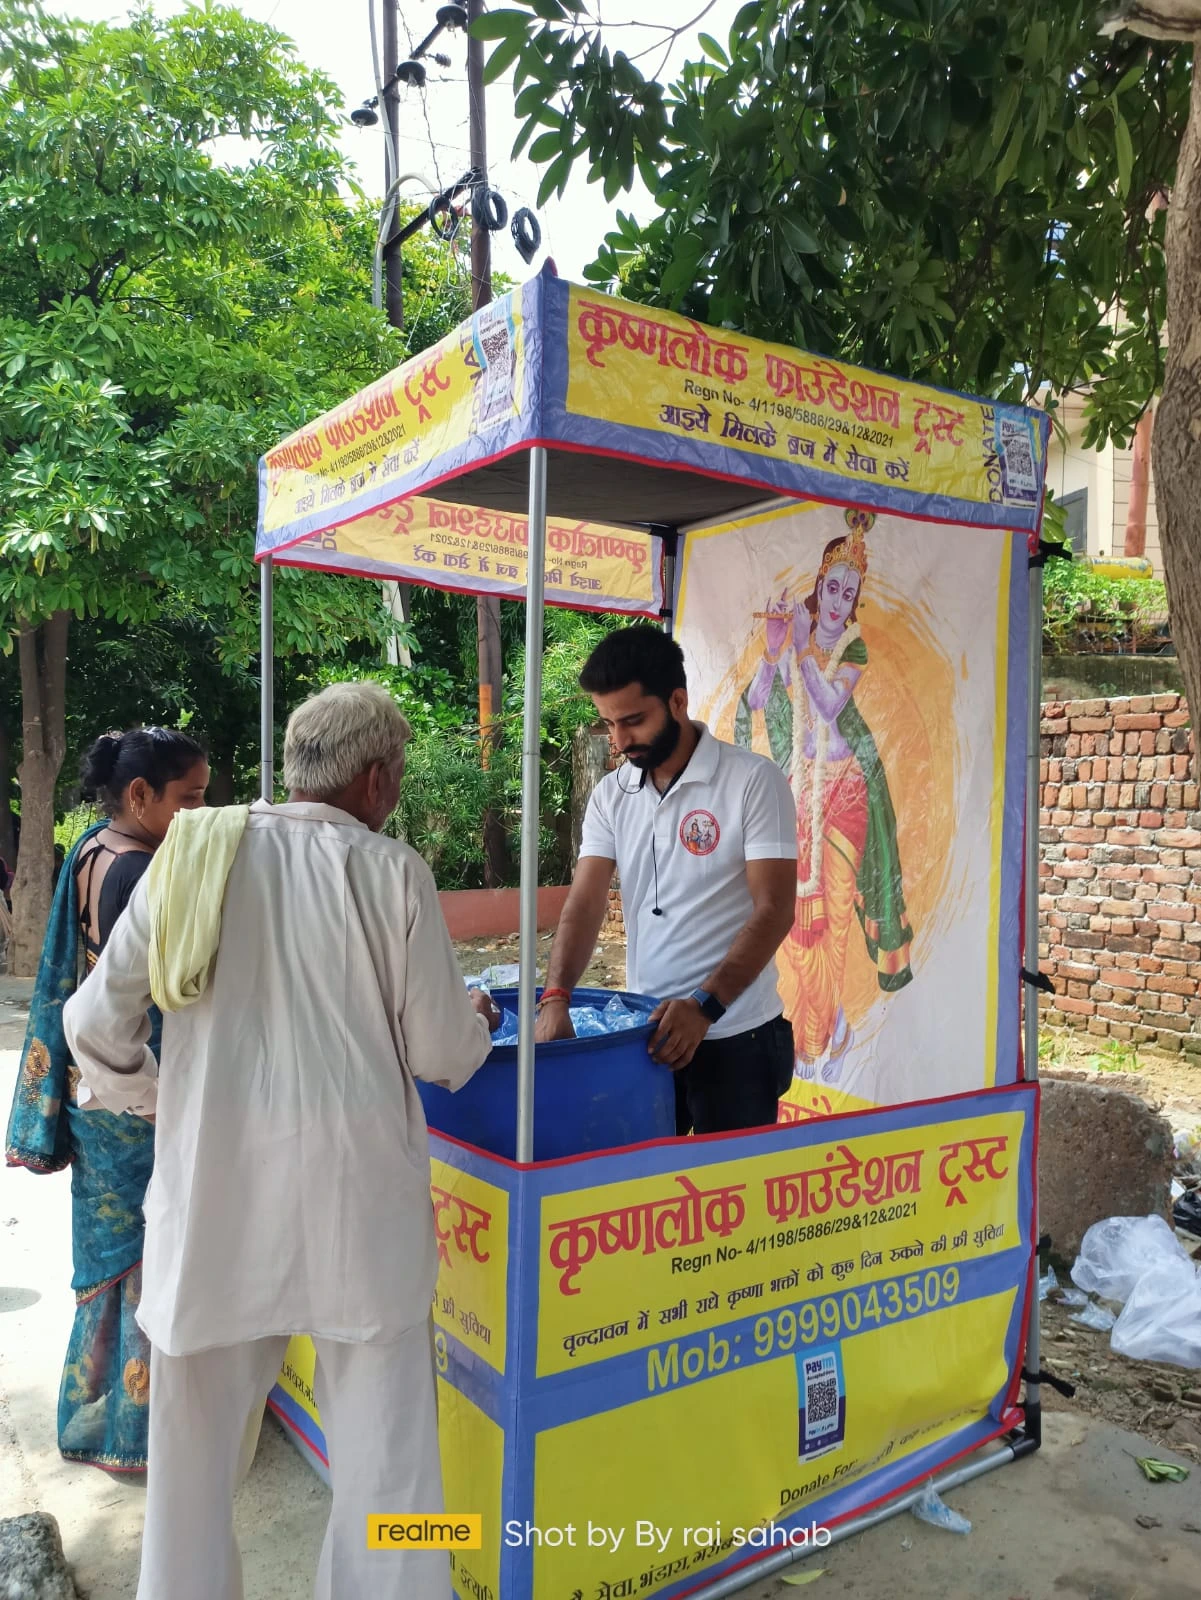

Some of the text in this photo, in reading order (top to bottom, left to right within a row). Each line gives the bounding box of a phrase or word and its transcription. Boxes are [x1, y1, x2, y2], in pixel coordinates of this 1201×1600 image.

[577, 299, 965, 455] कृष्णलोक फाउंडेशन ट्रस्ट
[684, 379, 895, 448] Regn No- 4/1198/5886/29&12&2021
[659, 403, 910, 482] आइये मिलके ब्रज में सेवा करें
[980, 405, 1004, 504] DONATE
[430, 1184, 491, 1269] ट्रस्ट
[548, 1136, 1009, 1297] कृष्णलोक फाउंडेशन ट्रस्ट
[671, 1202, 918, 1275] Regn No- 4/1198/5886/29&12&2021
[442, 1296, 455, 1319] फ्री
[459, 1310, 491, 1345] सुविधा
[562, 1319, 630, 1358] वृन्दावन
[637, 1310, 650, 1331] में
[658, 1299, 688, 1326] सभी
[695, 1290, 719, 1315] राधे
[727, 1282, 764, 1311] कृष्णा
[770, 1268, 800, 1293] भक्तों
[806, 1262, 824, 1282] को
[831, 1258, 855, 1282] कुछ
[860, 1250, 883, 1270] दिन
[889, 1239, 924, 1263] रुकने
[930, 1234, 947, 1253] की
[951, 1229, 968, 1251] फ्री
[646, 1265, 961, 1393] Mob: 9999043509
[780, 1473, 830, 1506] Donate
